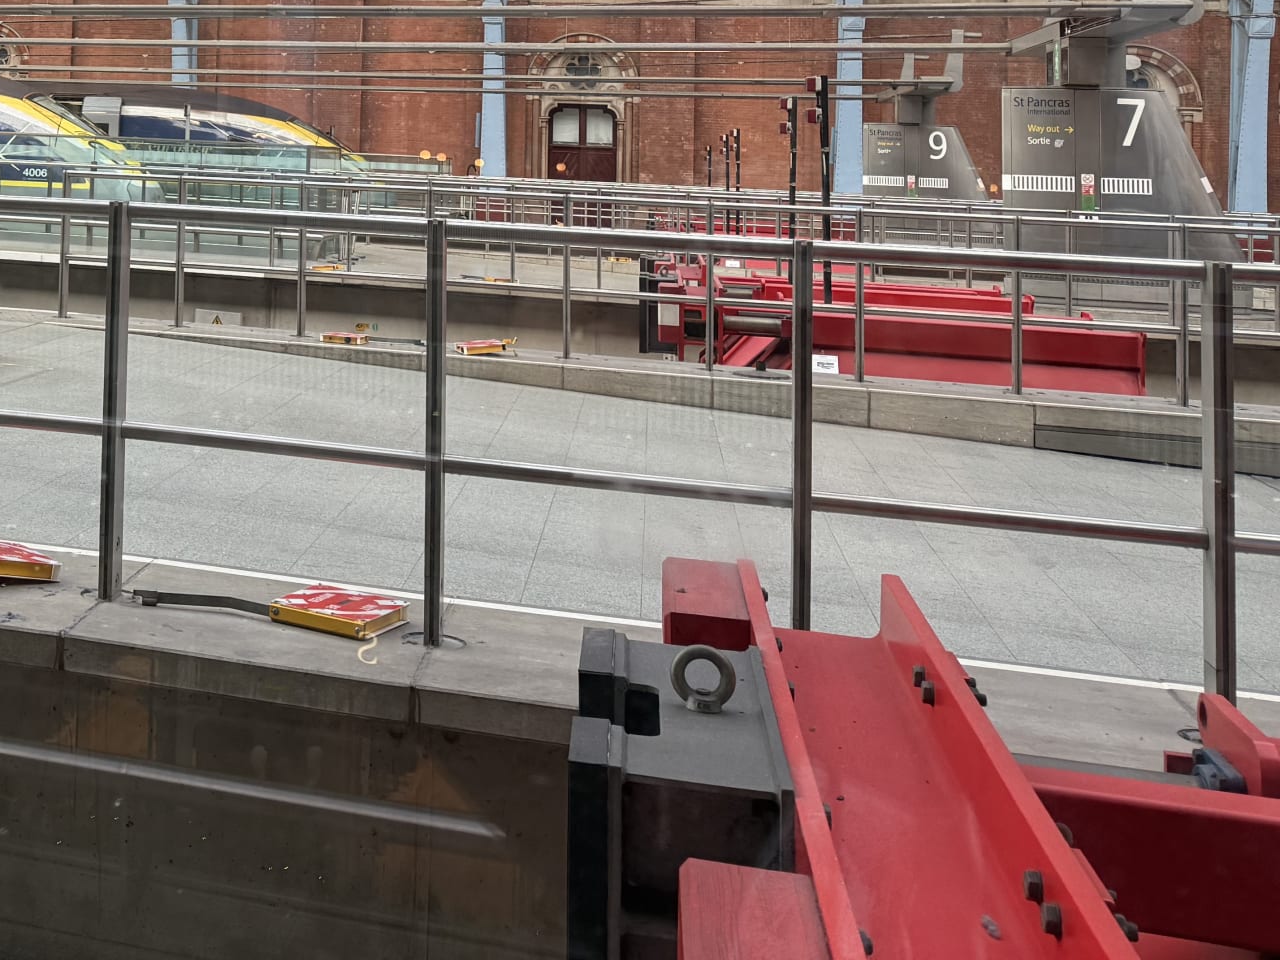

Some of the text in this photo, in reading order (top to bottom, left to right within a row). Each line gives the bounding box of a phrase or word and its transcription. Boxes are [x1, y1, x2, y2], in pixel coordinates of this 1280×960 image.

[1013, 96, 1071, 108] St Pancras
[1027, 108, 1071, 116] International
[1116, 97, 1146, 147] 7
[877, 128, 902, 137] Pancras
[1027, 124, 1060, 134] Way out
[928, 130, 948, 160] 9
[1027, 136, 1051, 145] Sortie
[22, 168, 48, 178] 4006
